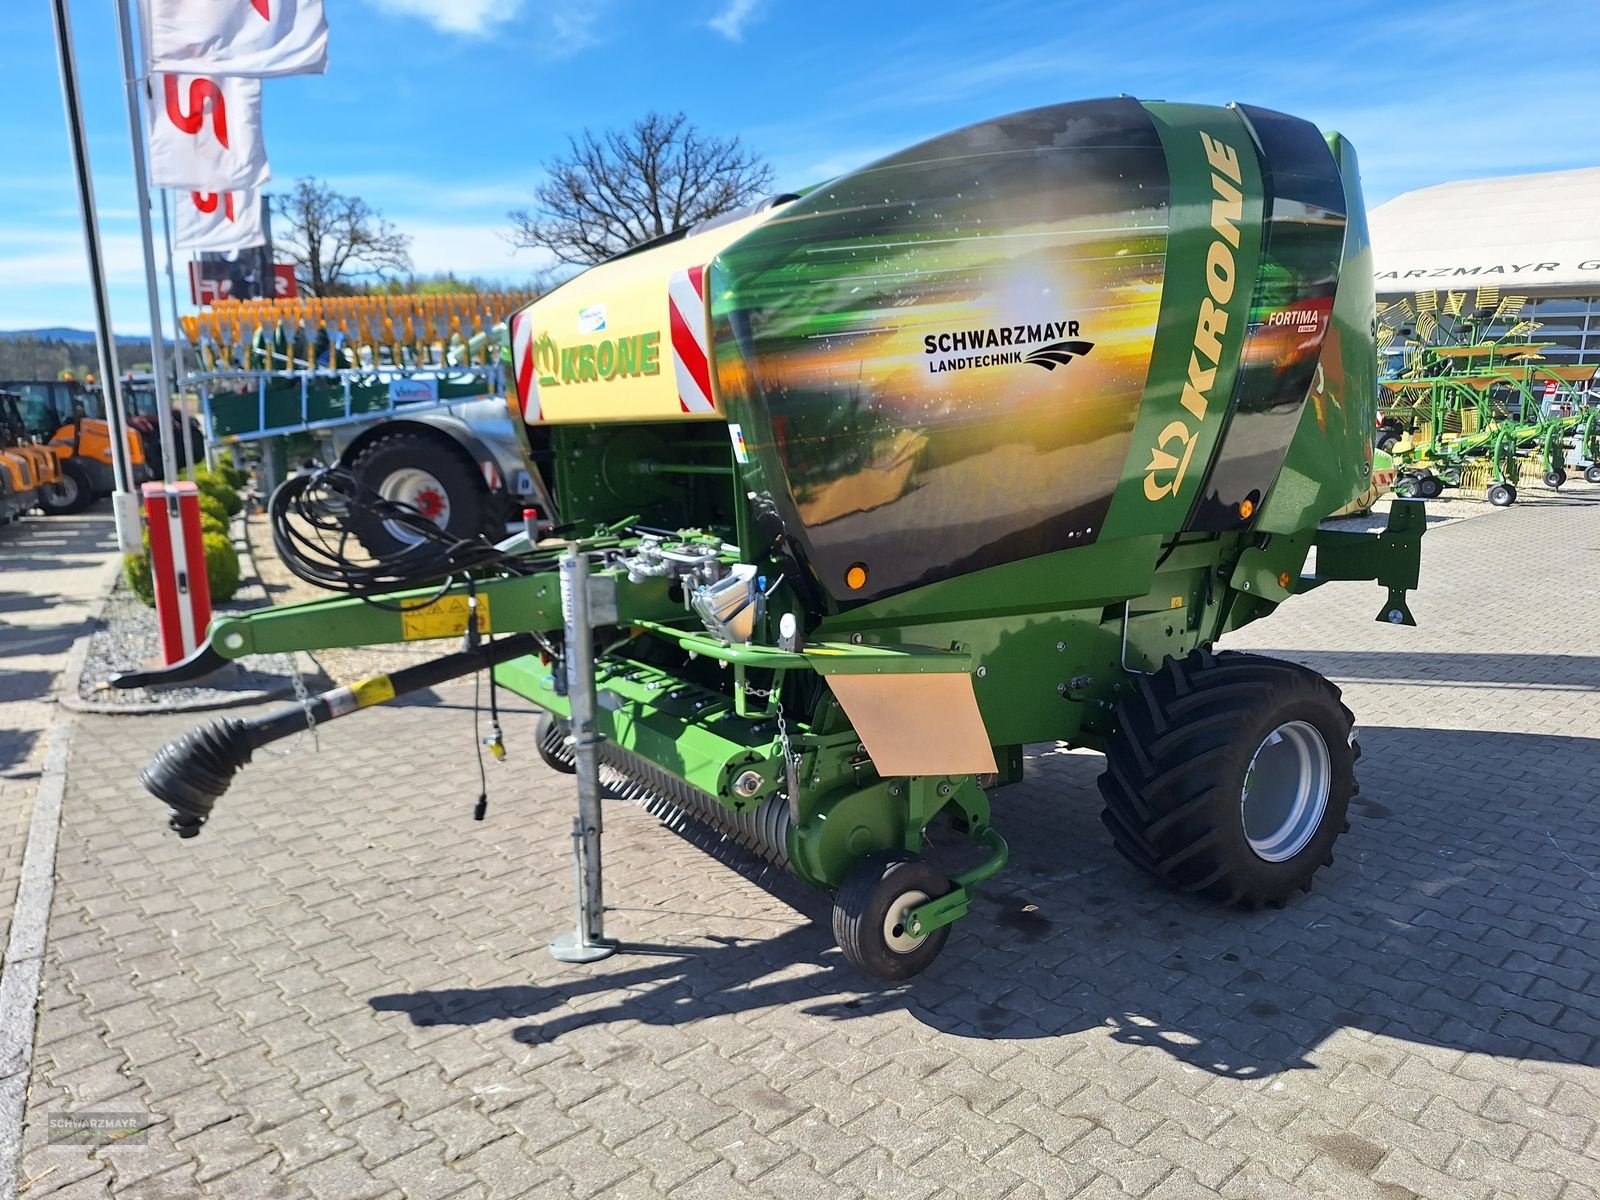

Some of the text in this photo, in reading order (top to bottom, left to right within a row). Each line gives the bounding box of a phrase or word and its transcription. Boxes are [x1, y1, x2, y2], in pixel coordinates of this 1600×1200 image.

[1180, 130, 1243, 421] KRONE
[1374, 262, 1560, 280] ARZMAYR
[1269, 310, 1318, 326] FORTIMA
[924, 320, 1080, 354] SCHWARZMAYR
[561, 331, 660, 384] KRONE
[930, 351, 1022, 373] LANDTECHNIK
